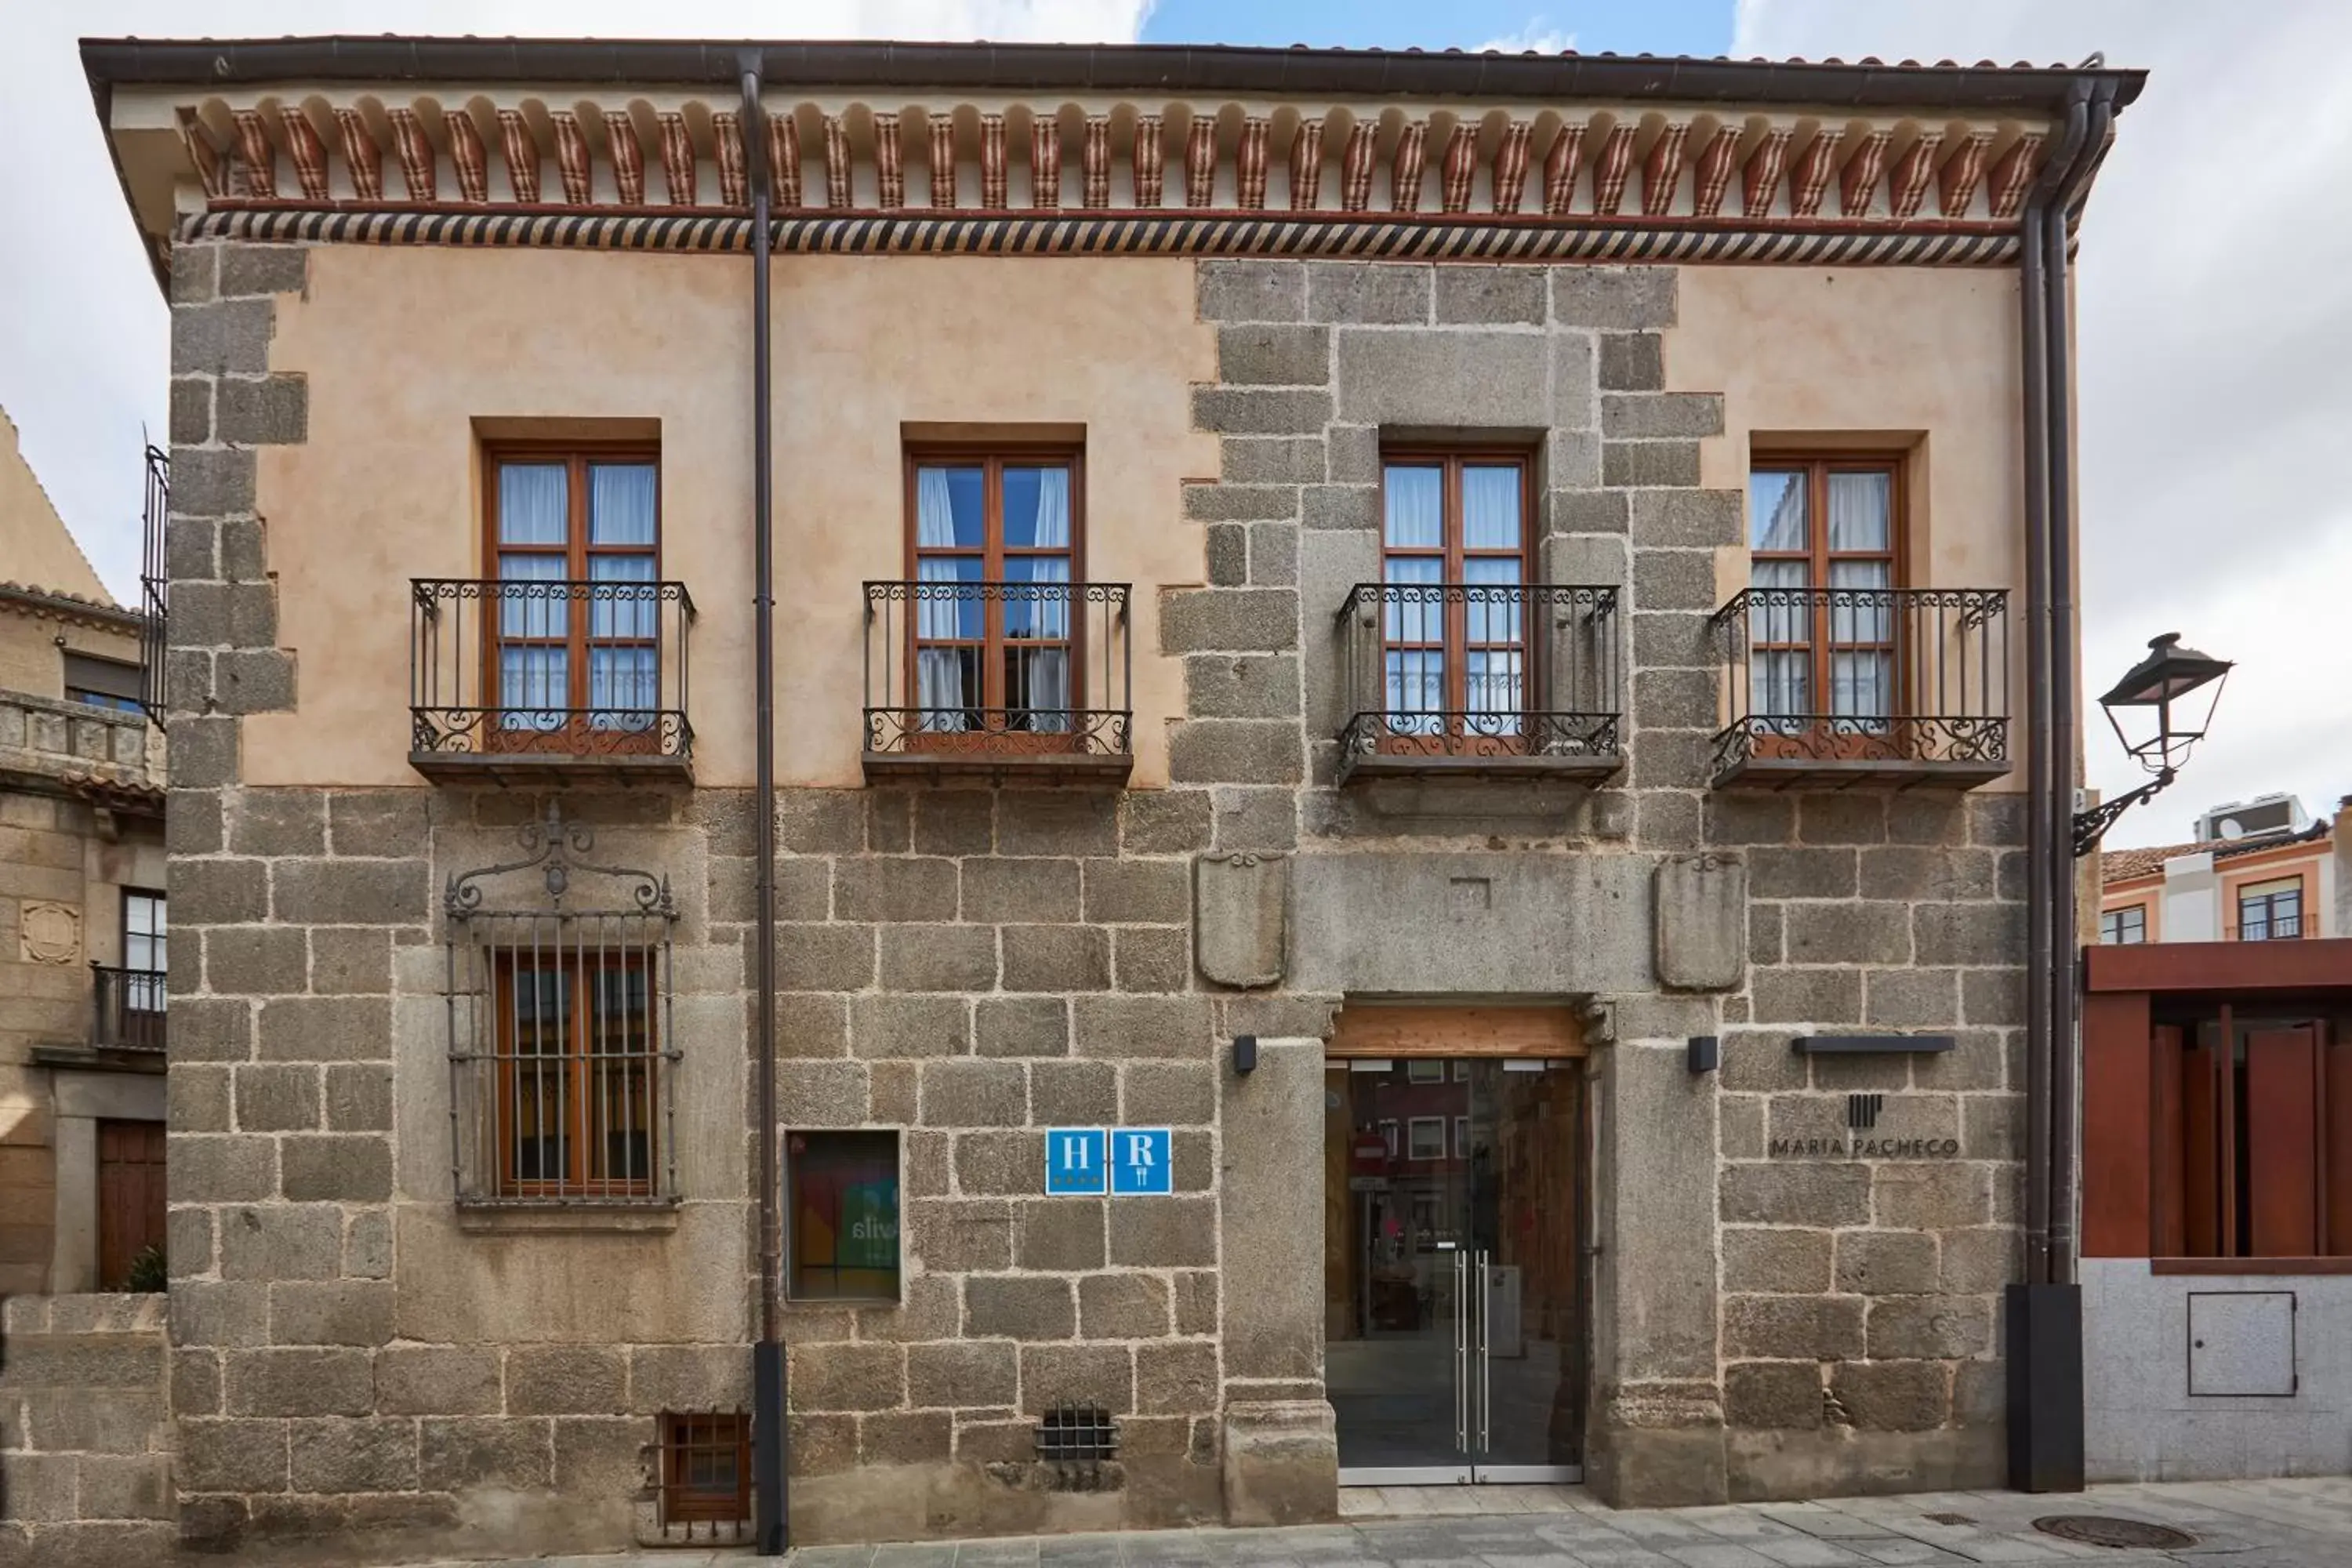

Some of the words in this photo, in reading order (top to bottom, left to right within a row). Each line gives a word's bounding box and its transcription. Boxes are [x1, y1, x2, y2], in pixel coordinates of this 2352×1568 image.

[1063, 1136, 1089, 1170] H
[1127, 1134, 1156, 1166] R
[1853, 1138, 1959, 1155] PACHECO
